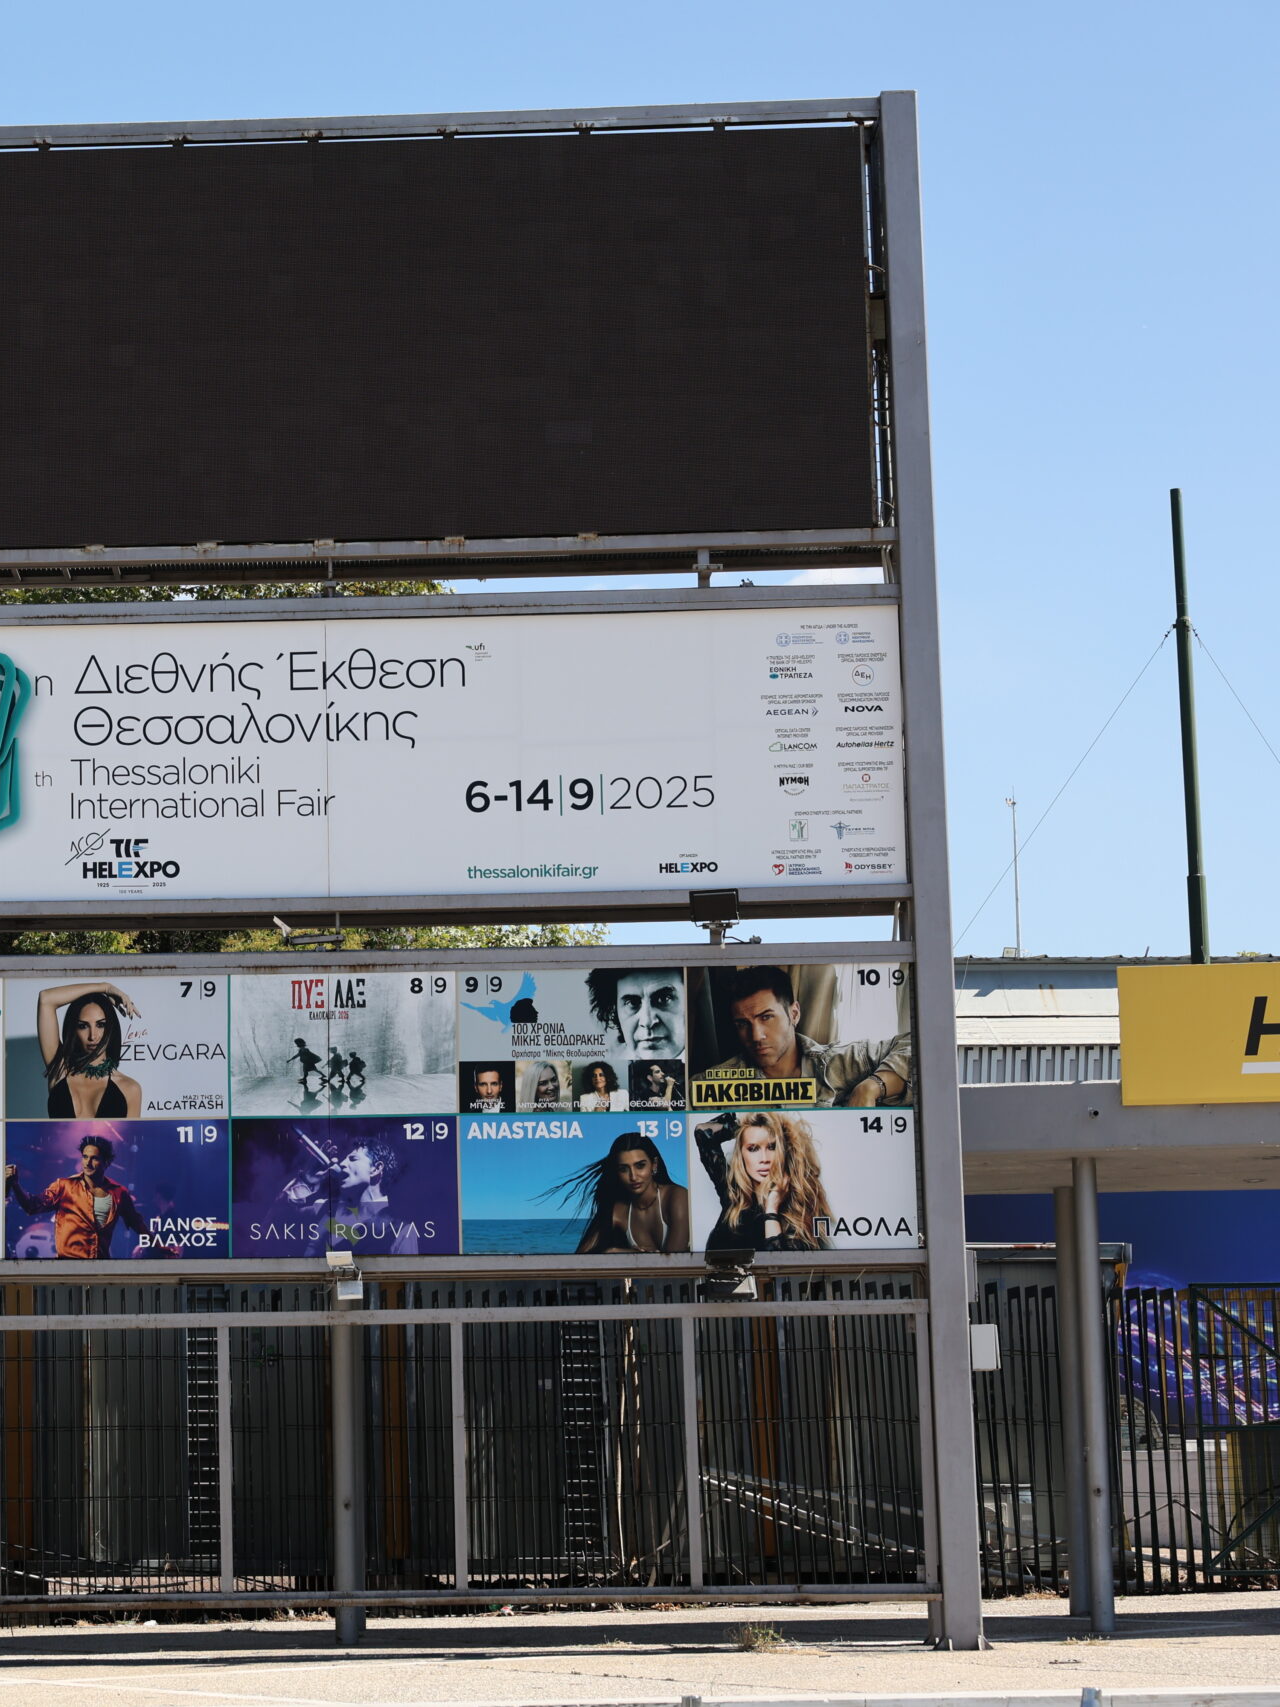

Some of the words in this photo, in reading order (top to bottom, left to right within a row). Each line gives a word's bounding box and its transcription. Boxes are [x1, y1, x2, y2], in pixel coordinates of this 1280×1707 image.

[73, 651, 265, 700] Διεθνής
[276, 648, 466, 690] Έκθεση
[73, 701, 418, 749] Θεσσαλονίκης
[34, 771, 53, 787] th
[70, 756, 261, 786] Thessaloniki
[779, 776, 809, 787] ΝΥΜΦΗ
[70, 789, 265, 820] International
[276, 788, 336, 818] Fair
[82, 861, 180, 879] HELEXPO
[467, 864, 599, 880] thessalonikifair.gr
[659, 861, 718, 873] HELEXPO
[512, 1023, 528, 1034] 100
[530, 1022, 565, 1034] ΧΡΟΝΙΑ
[512, 1035, 541, 1046] ΜΙΚΗΣ
[544, 1034, 606, 1046] ΘΕΟΔΩΡΑΚΗΣ
[120, 1043, 227, 1061] ZEVGARA
[706, 1069, 754, 1079] ΠΕΤΡΟΣ
[696, 1082, 813, 1103] ΙΑΚΩΒΙΔΗΣ
[147, 1100, 224, 1111] ALCATRASH
[467, 1121, 583, 1140] ANASTASIA
[150, 1217, 217, 1232] ΠΑΝΟΣ
[813, 1216, 913, 1237] ΠΑΟΛΑ
[139, 1232, 218, 1247] ΒΛΑΧΟΣ
